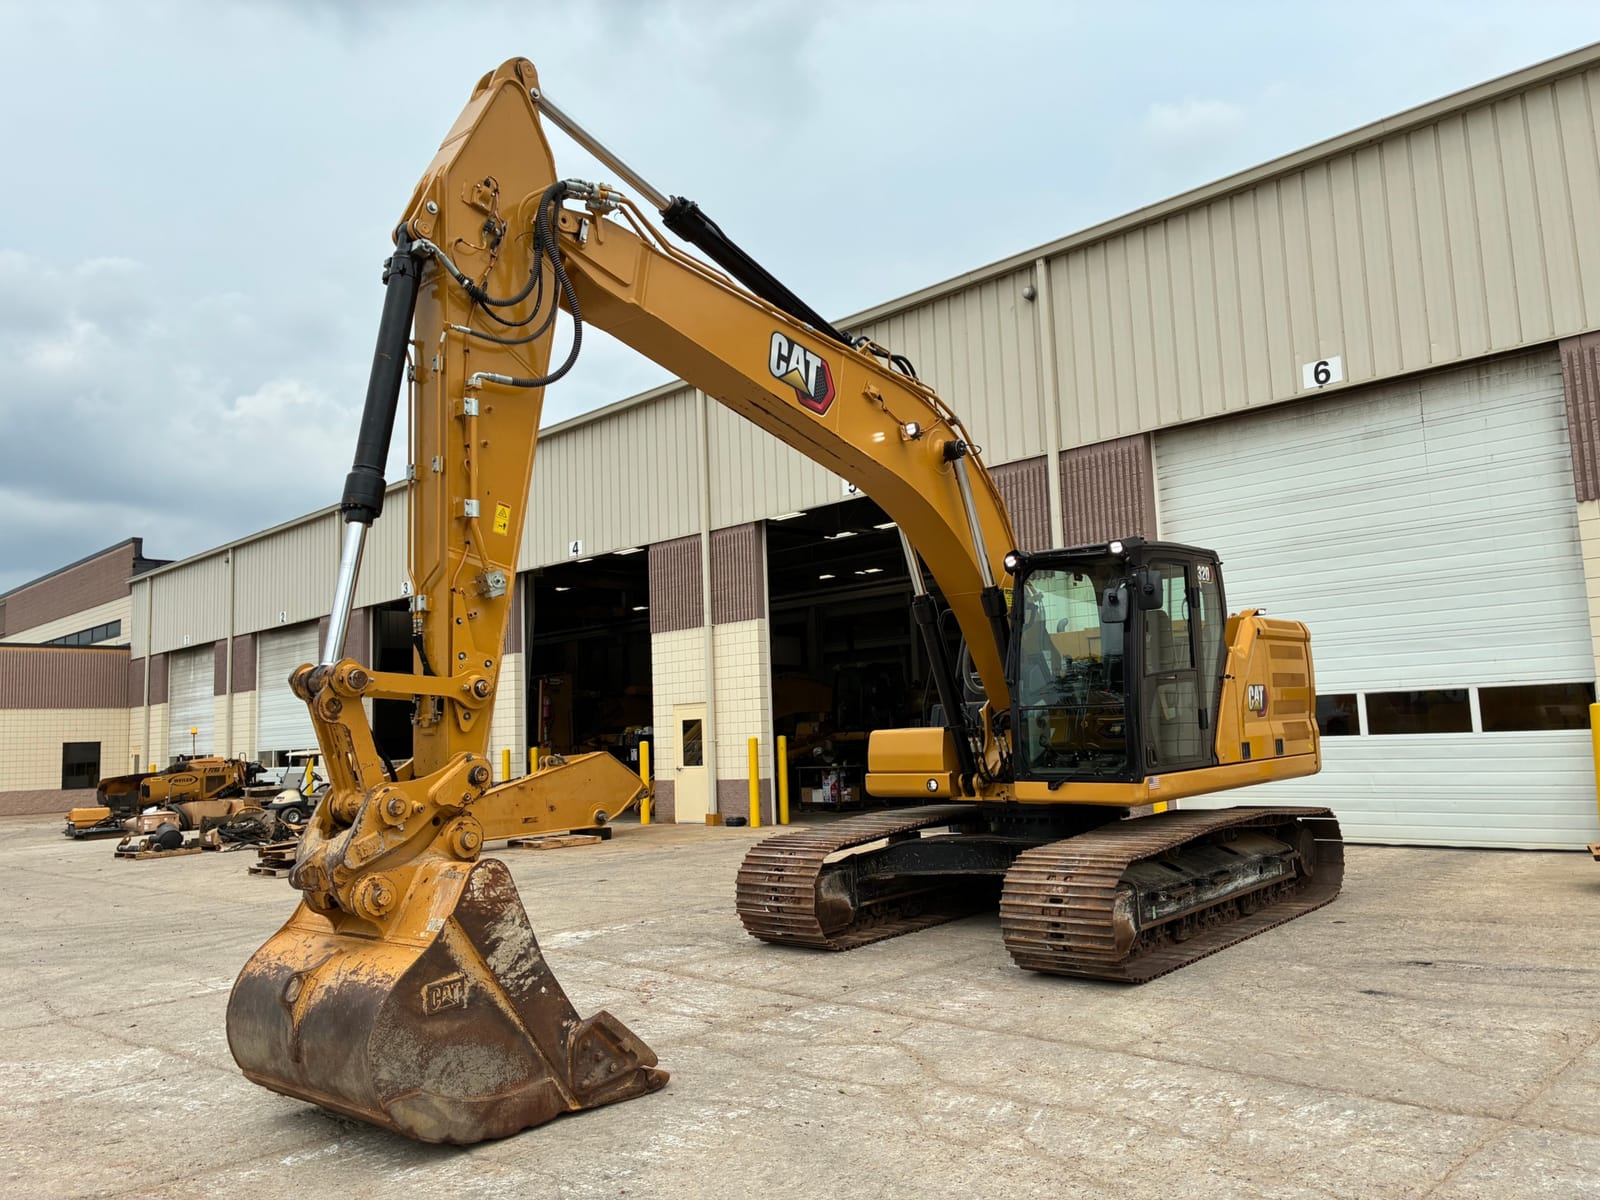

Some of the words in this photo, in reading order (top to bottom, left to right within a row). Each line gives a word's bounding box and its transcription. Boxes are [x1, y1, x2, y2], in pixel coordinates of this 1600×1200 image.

[769, 332, 822, 397] CAT
[1313, 360, 1331, 385] 6
[572, 541, 579, 555] 4
[1197, 565, 1210, 580] 320
[403, 582, 409, 594] 3
[1248, 685, 1264, 710] CAT
[430, 982, 463, 1011] CAT
